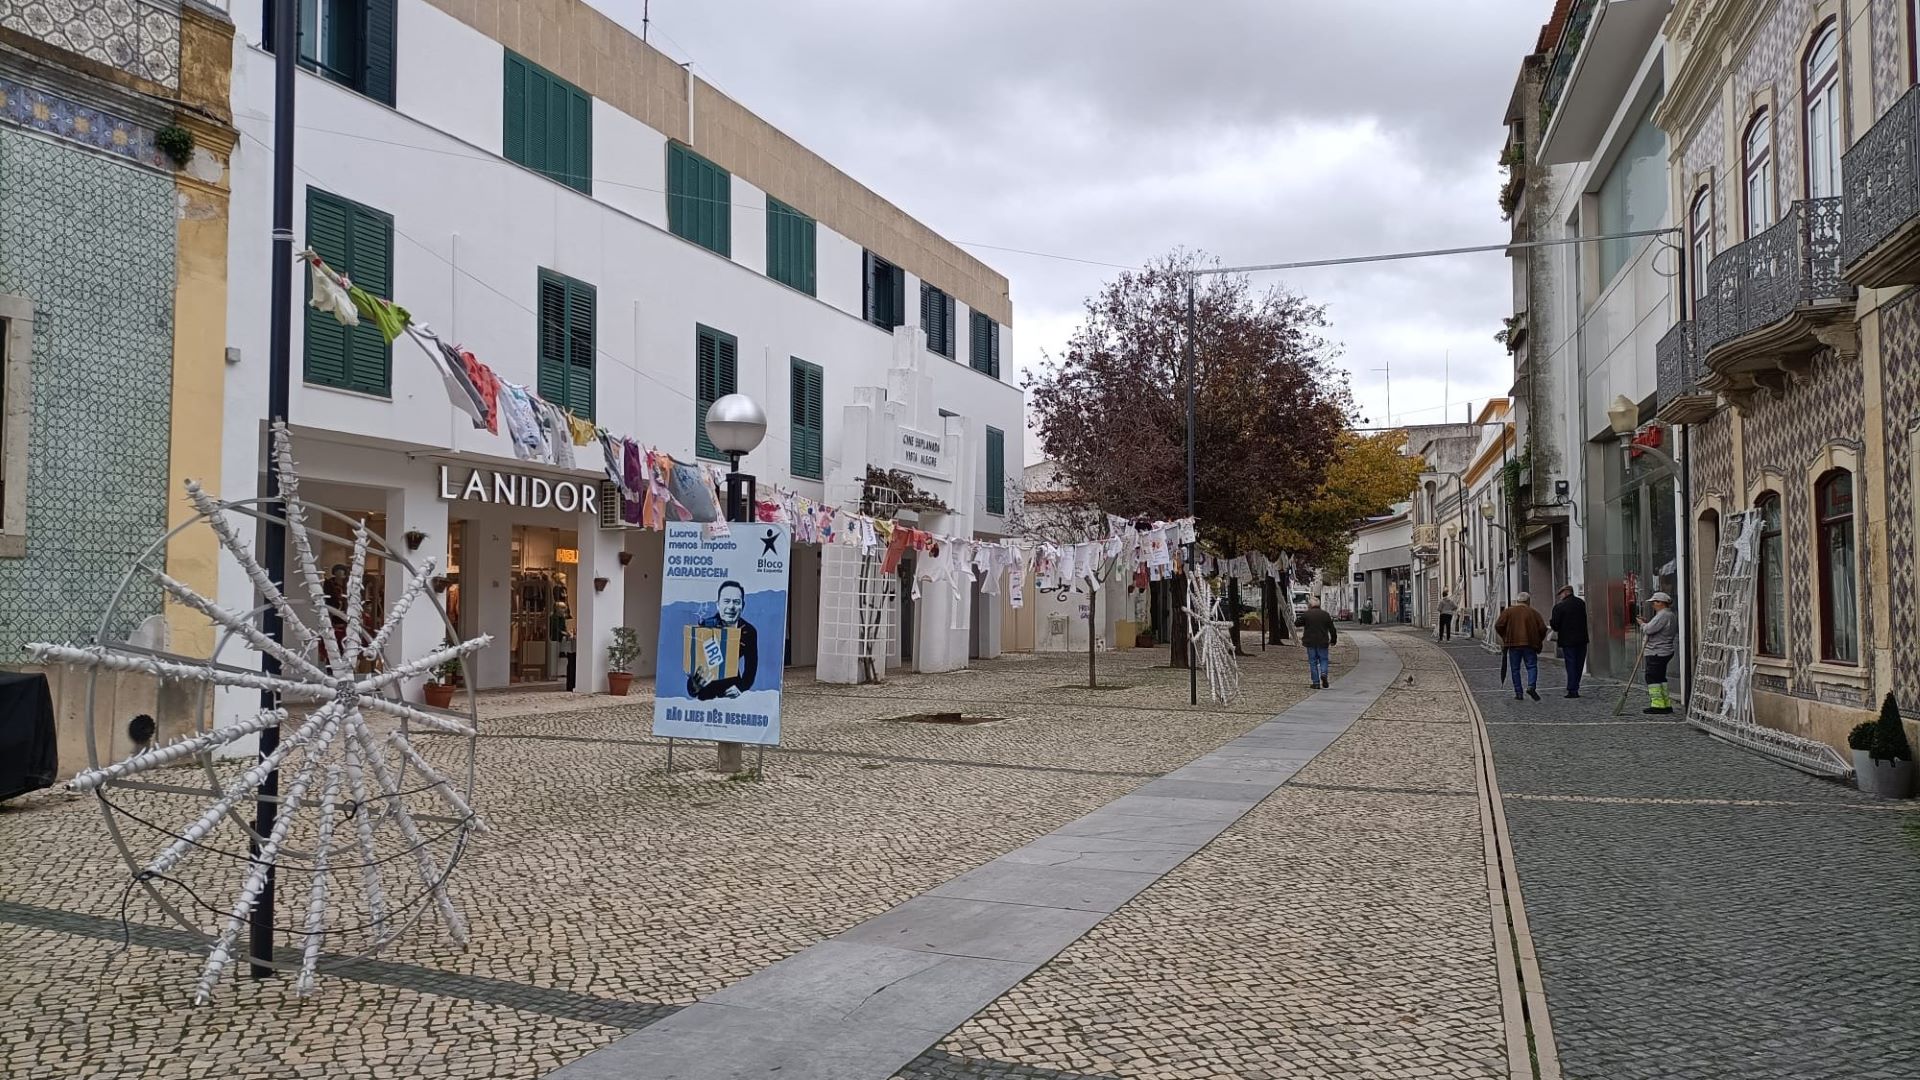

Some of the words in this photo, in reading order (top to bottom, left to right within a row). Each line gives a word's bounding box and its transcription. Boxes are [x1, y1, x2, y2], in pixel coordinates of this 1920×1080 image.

[902, 434, 914, 446] CINE
[439, 465, 598, 514] LANIDOR
[669, 528, 698, 538] Lucros
[668, 541, 698, 550] menos
[701, 540, 737, 552] imposto
[668, 556, 682, 565] OS
[683, 556, 714, 566] RICOS
[757, 559, 783, 568] Bloco
[666, 566, 729, 578] AGRADECEM
[704, 641, 722, 667] IRC
[666, 706, 683, 721] NÃO
[684, 710, 705, 723] LHES
[706, 708, 723, 724] DÊS
[725, 712, 769, 728] DESCANSO
